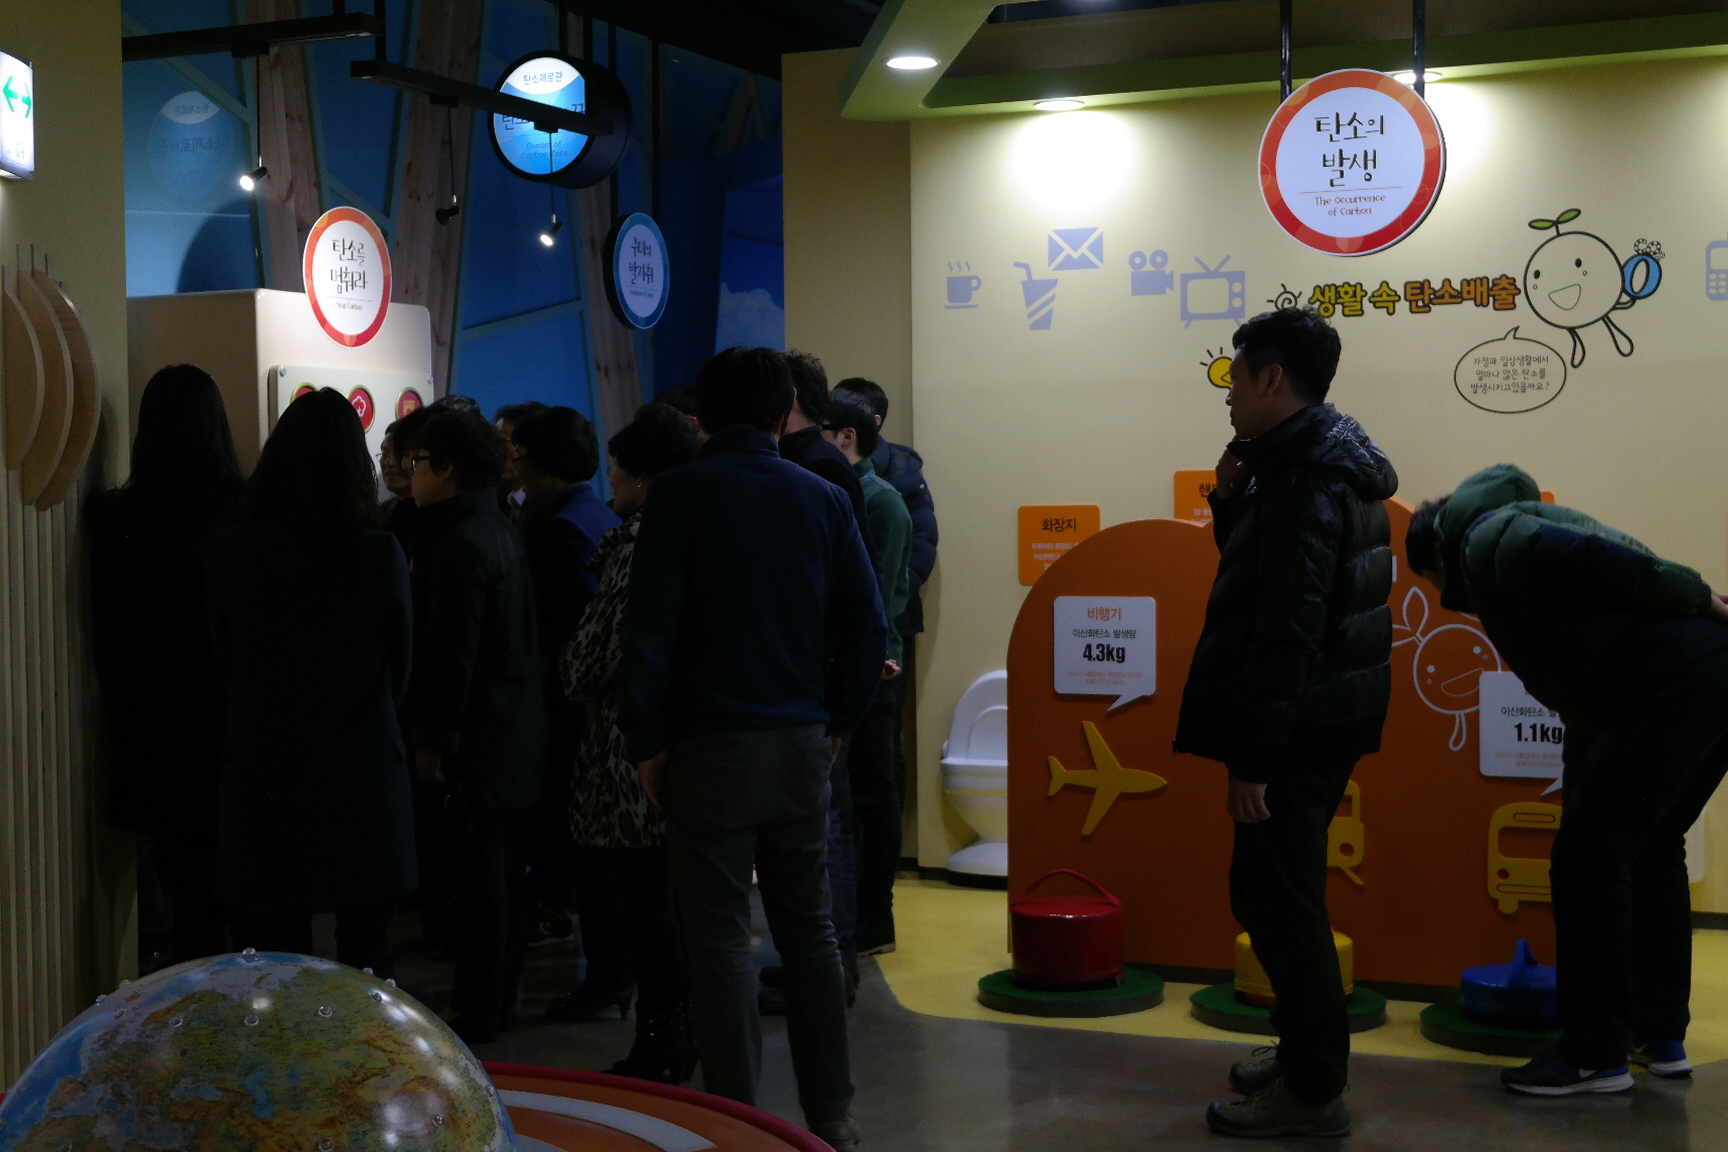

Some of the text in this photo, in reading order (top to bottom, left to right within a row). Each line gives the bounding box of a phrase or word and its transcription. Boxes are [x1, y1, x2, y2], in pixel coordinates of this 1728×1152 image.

[523, 71, 563, 86] 탄소제로관
[1313, 111, 1385, 143] 탄소의
[1322, 148, 1377, 188] 발생
[1315, 194, 1386, 206] The Occurrence
[1328, 207, 1372, 217] of Carbon
[332, 237, 366, 267] 탄소를
[330, 266, 369, 294] 멈춰라
[1308, 273, 1522, 318] 생활 속 탄소배출
[1500, 354, 1549, 367] 일상생활에서
[1475, 367, 1547, 381] 얼마나 많은 탄소를
[1041, 517, 1077, 533] 화장지
[1087, 606, 1122, 621] 비행기
[1072, 628, 1137, 639] 이산화탄소 발생량
[1082, 643, 1126, 664] 4.3kg
[1500, 706, 1546, 717] 이산화탄소
[1514, 722, 1563, 745] 1.1kg
